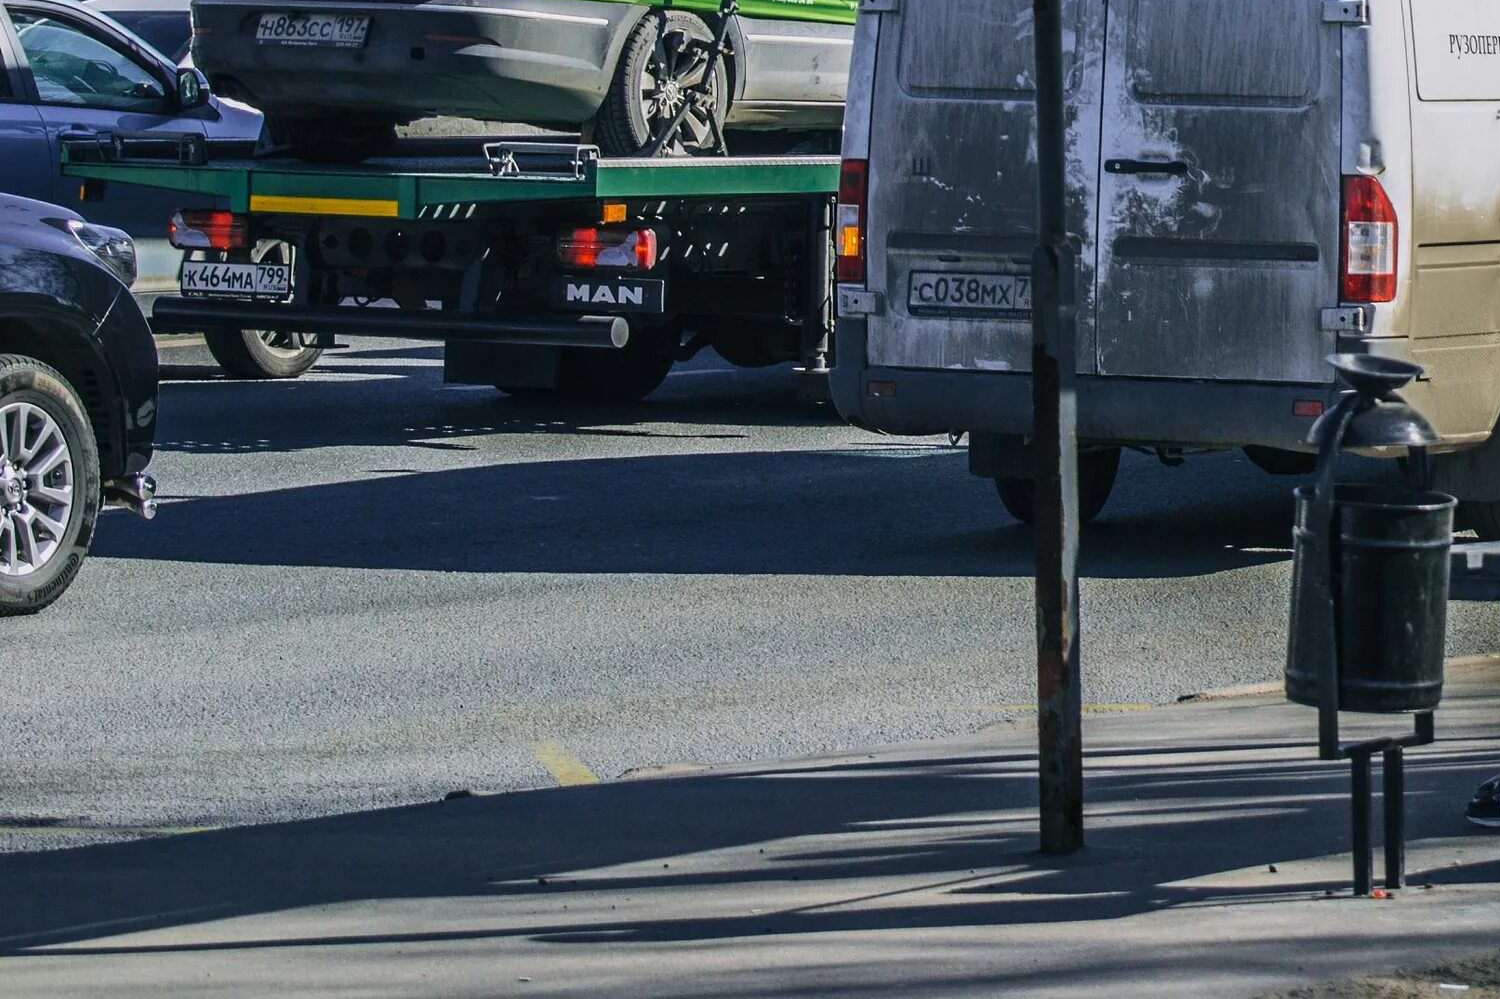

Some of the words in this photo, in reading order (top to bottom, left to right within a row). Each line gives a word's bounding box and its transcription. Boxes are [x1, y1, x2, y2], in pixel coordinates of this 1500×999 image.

[188, 265, 253, 290] К464МА
[258, 266, 285, 285] 799
[566, 283, 643, 305] MAN
[919, 277, 1011, 305] С038МХ
[34, 552, 80, 603] Continental
